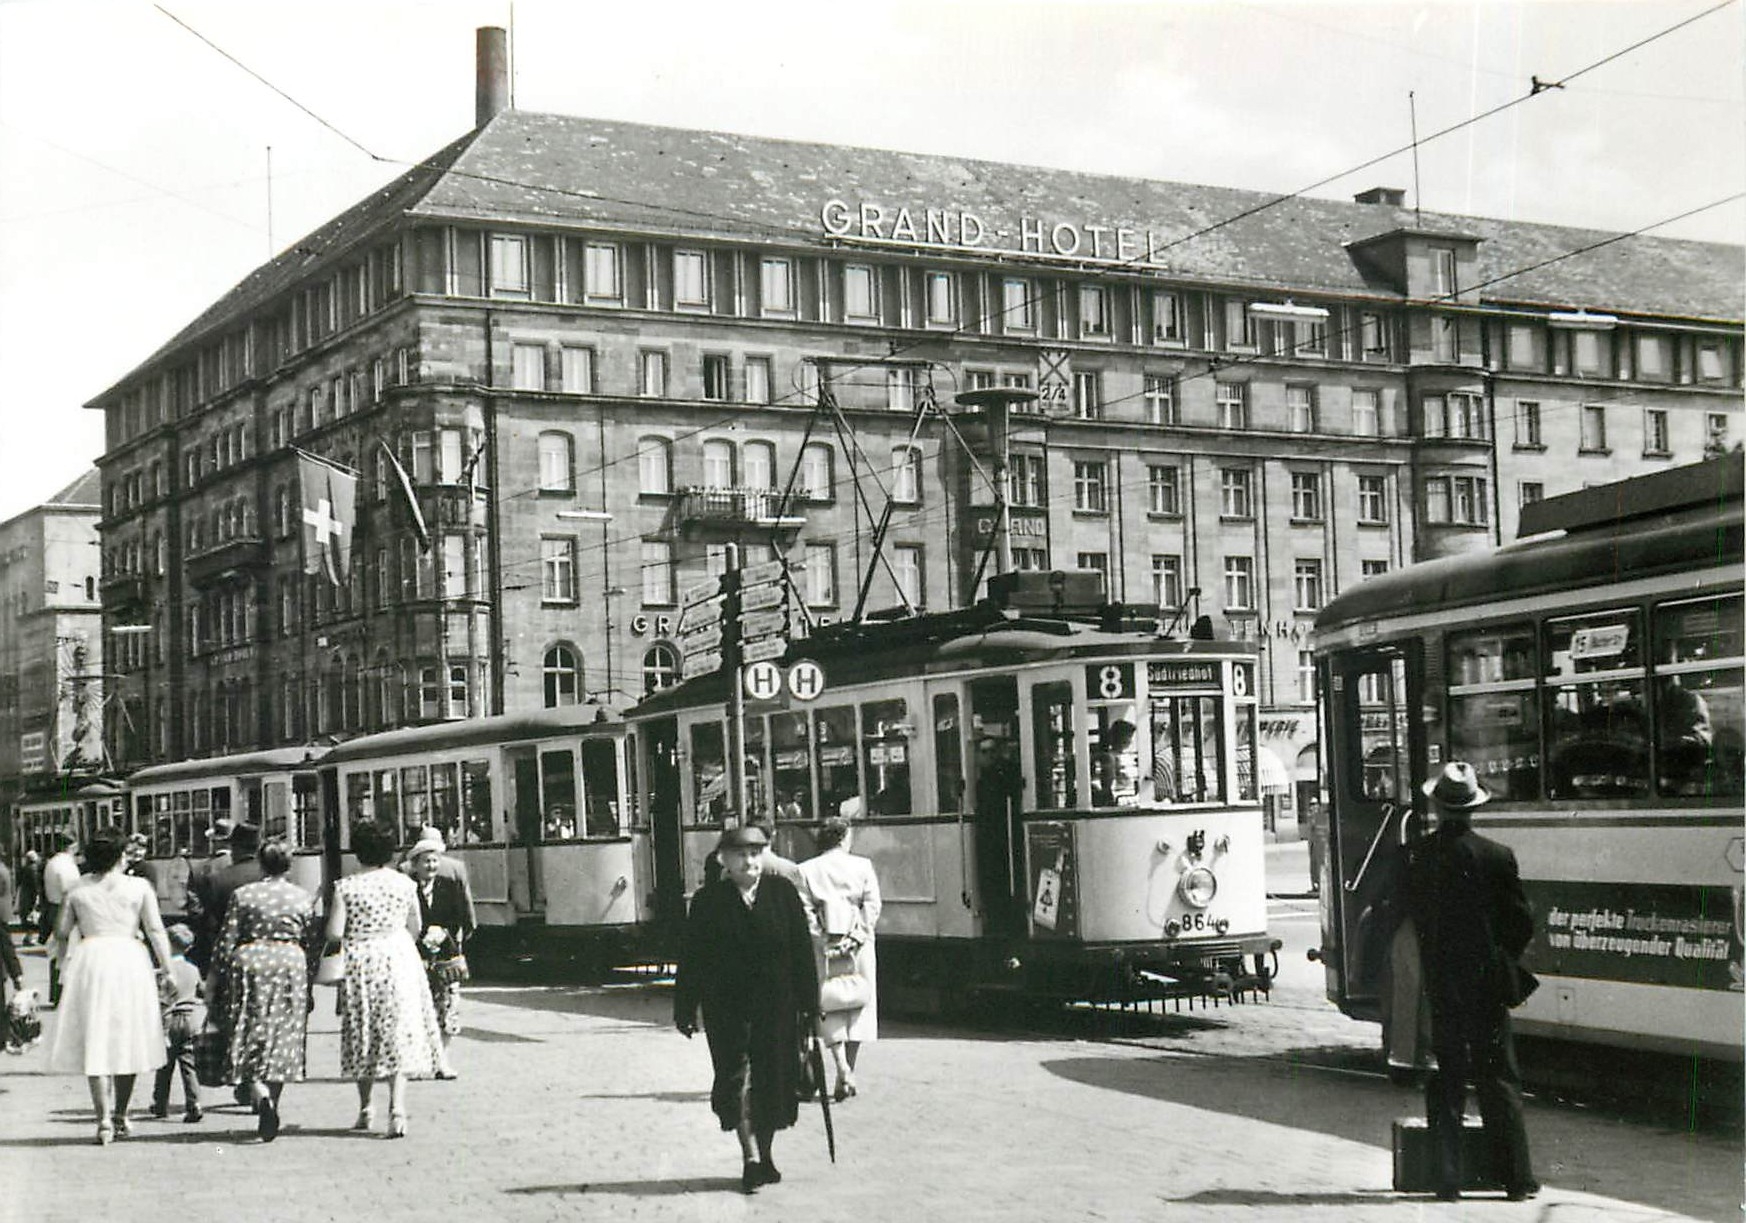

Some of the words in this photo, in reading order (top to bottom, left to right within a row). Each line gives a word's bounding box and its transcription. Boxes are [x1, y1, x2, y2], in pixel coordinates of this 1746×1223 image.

[754, 668, 773, 694] H
[797, 668, 816, 694] H
[1100, 665, 1123, 698] 8
[1233, 664, 1246, 696] 8
[1182, 913, 1215, 932] 864
[1549, 906, 1568, 926] der
[1570, 909, 1625, 932] perfekte
[1549, 933, 1570, 948] von
[1674, 936, 1730, 960] Qualität
